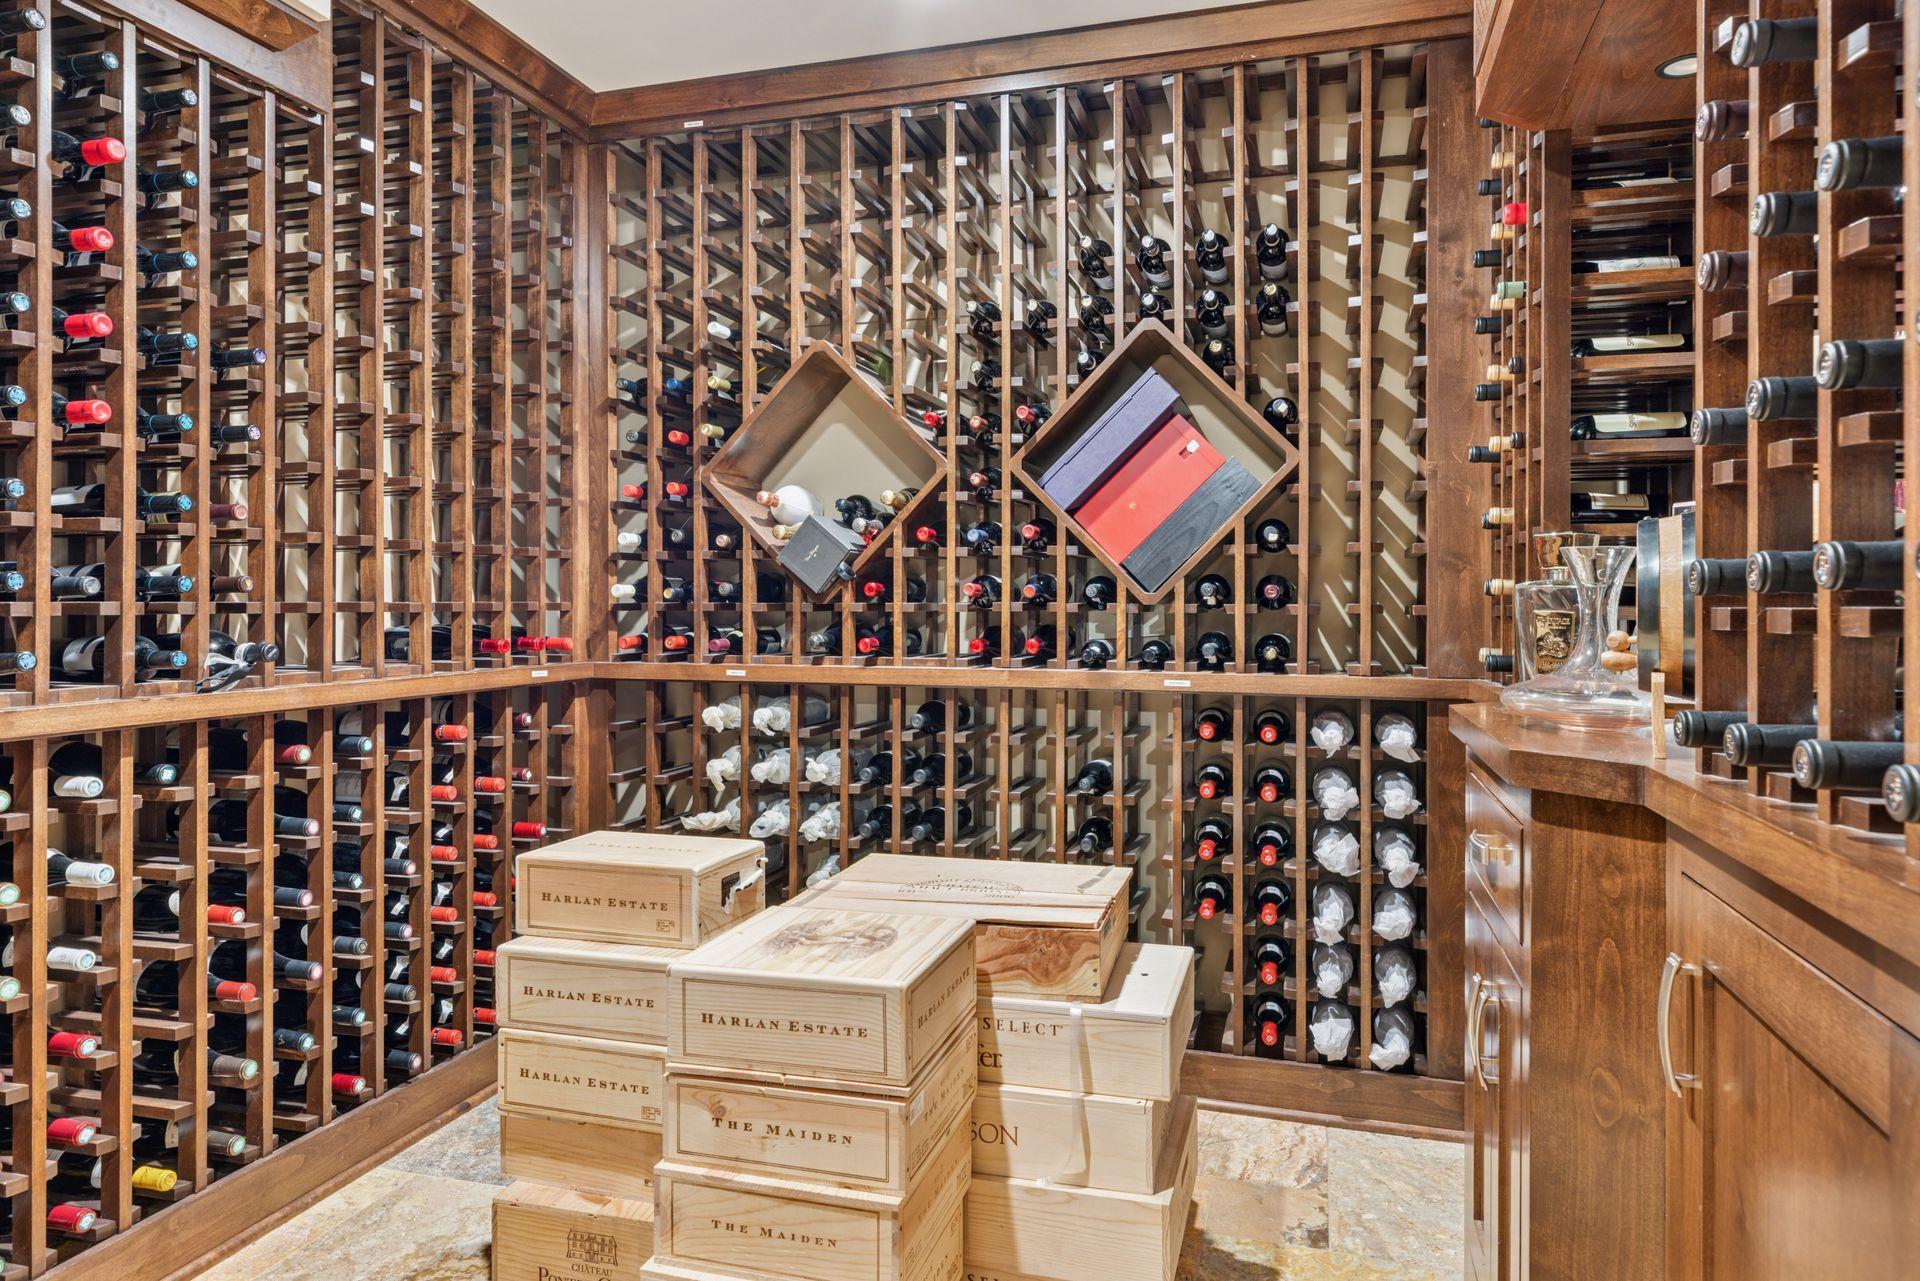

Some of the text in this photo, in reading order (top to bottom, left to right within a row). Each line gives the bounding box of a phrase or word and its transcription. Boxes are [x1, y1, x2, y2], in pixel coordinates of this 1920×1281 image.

[541, 891, 669, 912] HARLAN ESTATE
[523, 985, 655, 1008] HARLAN ESTATE
[701, 1012, 869, 1038] HARLAN ESTATE
[519, 1067, 650, 1095] HARLAN ESTATE
[711, 1117, 853, 1145] THE MAIDEN
[711, 1219, 838, 1249] THE MAIDEN
